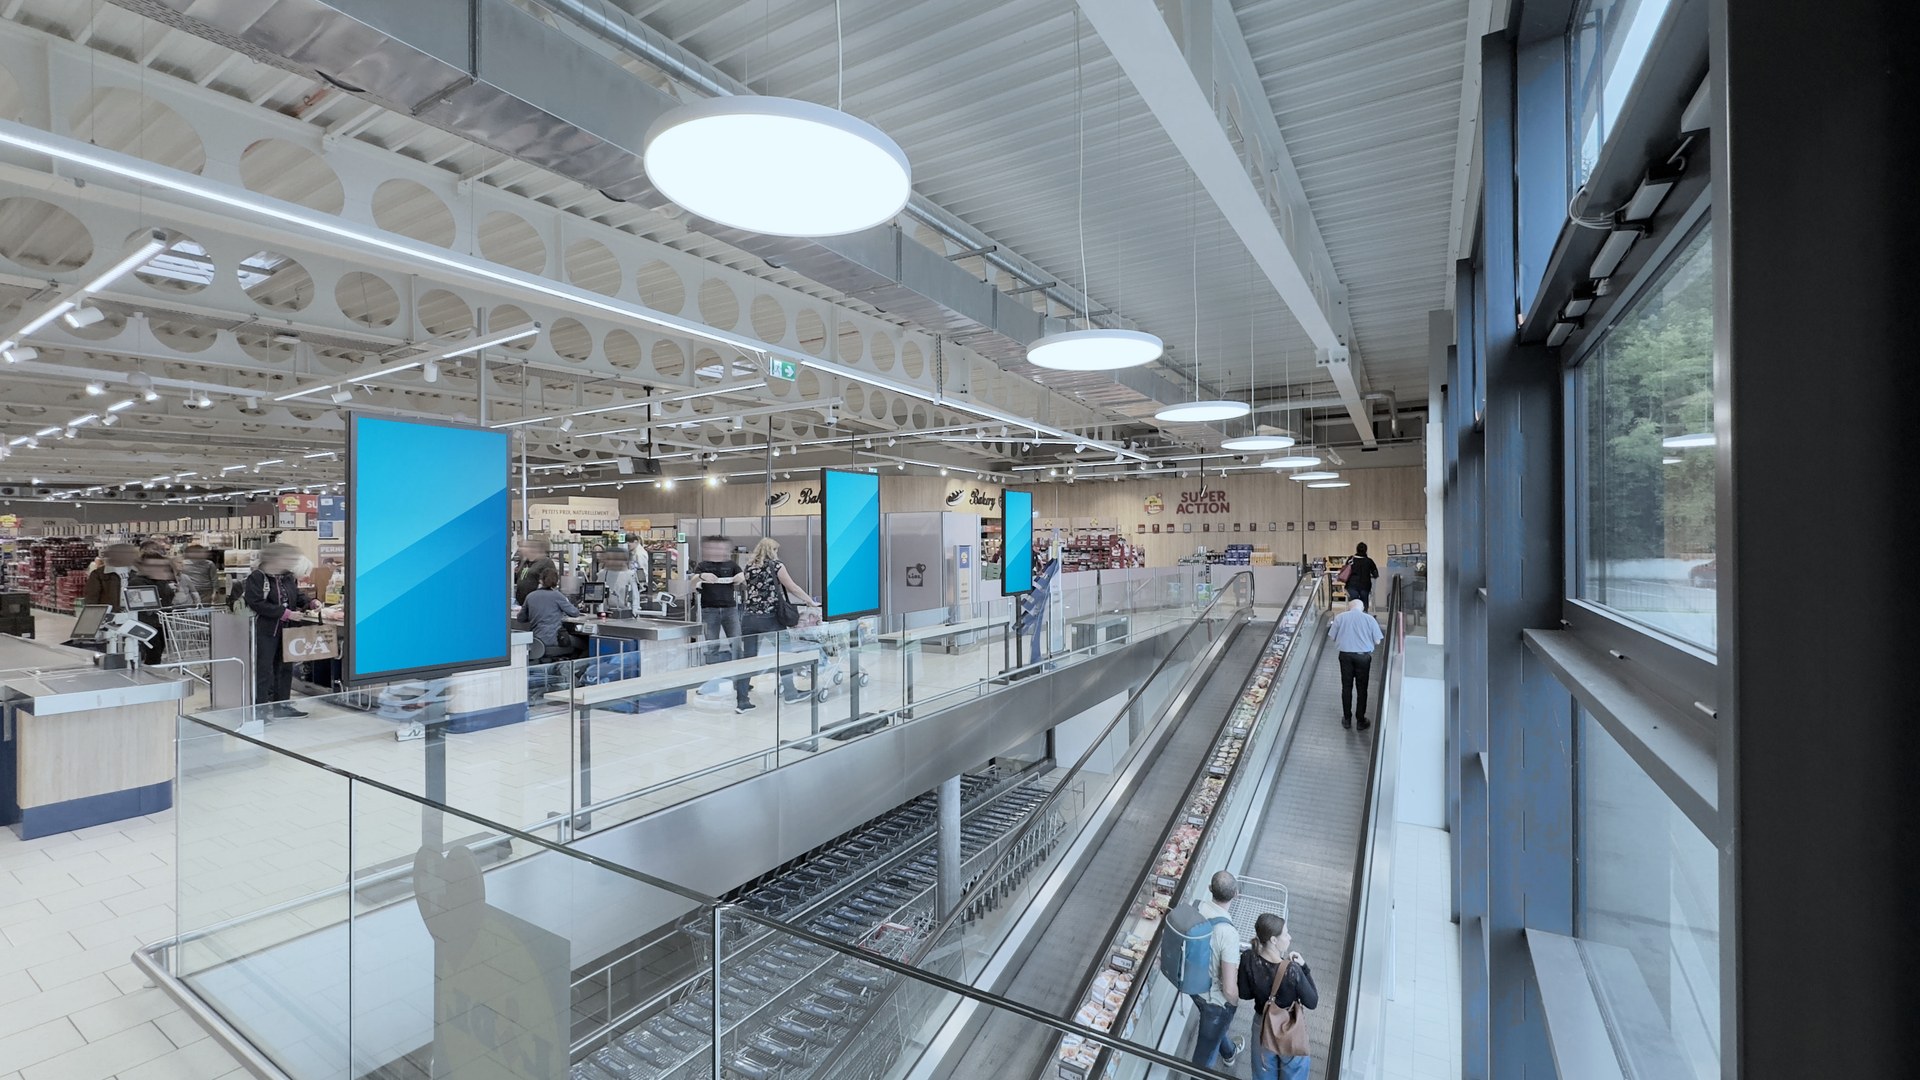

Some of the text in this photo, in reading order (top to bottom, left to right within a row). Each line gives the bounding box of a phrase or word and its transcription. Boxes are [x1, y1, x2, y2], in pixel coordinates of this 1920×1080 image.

[969, 488, 995, 511] Bakery
[1181, 491, 1226, 503] SUPER
[1176, 502, 1230, 514] ACTION
[288, 636, 331, 656] C&A
